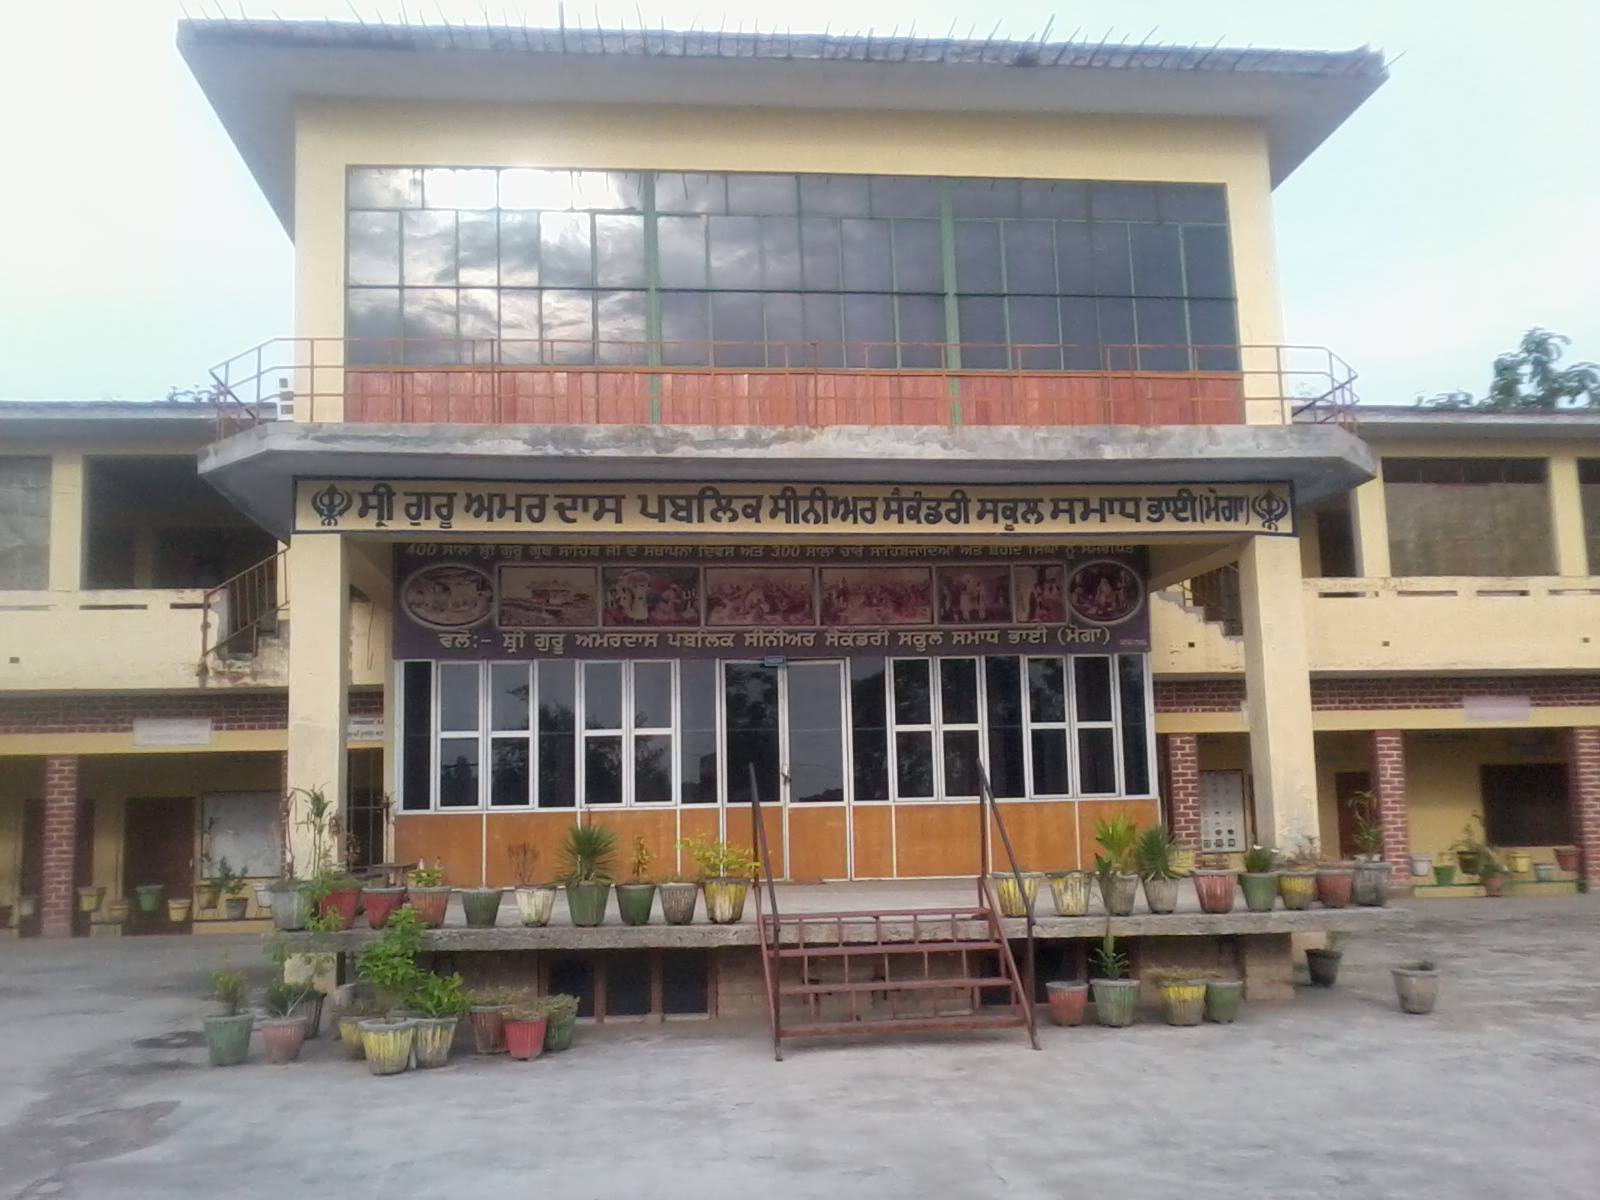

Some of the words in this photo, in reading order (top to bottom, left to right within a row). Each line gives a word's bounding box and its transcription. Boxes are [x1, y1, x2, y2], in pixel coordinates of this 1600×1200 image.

[403, 492, 457, 529] ਗੁਰੂ
[637, 486, 763, 523] ਪਬਲਿਕ
[769, 486, 878, 524] ਸੀਨੀਅਰ
[883, 487, 971, 524] ਸੈਕੰਡਰੀ
[977, 498, 1044, 531] ਸਕੂਲ
[1146, 487, 1198, 523] ਭਾਈ
[771, 545, 800, 557] 300
[535, 633, 566, 655] ਗੁਰੂ
[575, 633, 659, 649] ਅਮਰਦਾਸ
[667, 629, 736, 649] ਪਬਲਿਕ
[744, 628, 816, 647] ਸੀਨੀਅਰ
[897, 630, 944, 652] ਸਕੂਲ
[1008, 625, 1048, 644] ਭਾਈ
[1057, 624, 1110, 646] (ਮੋਗਾ)
